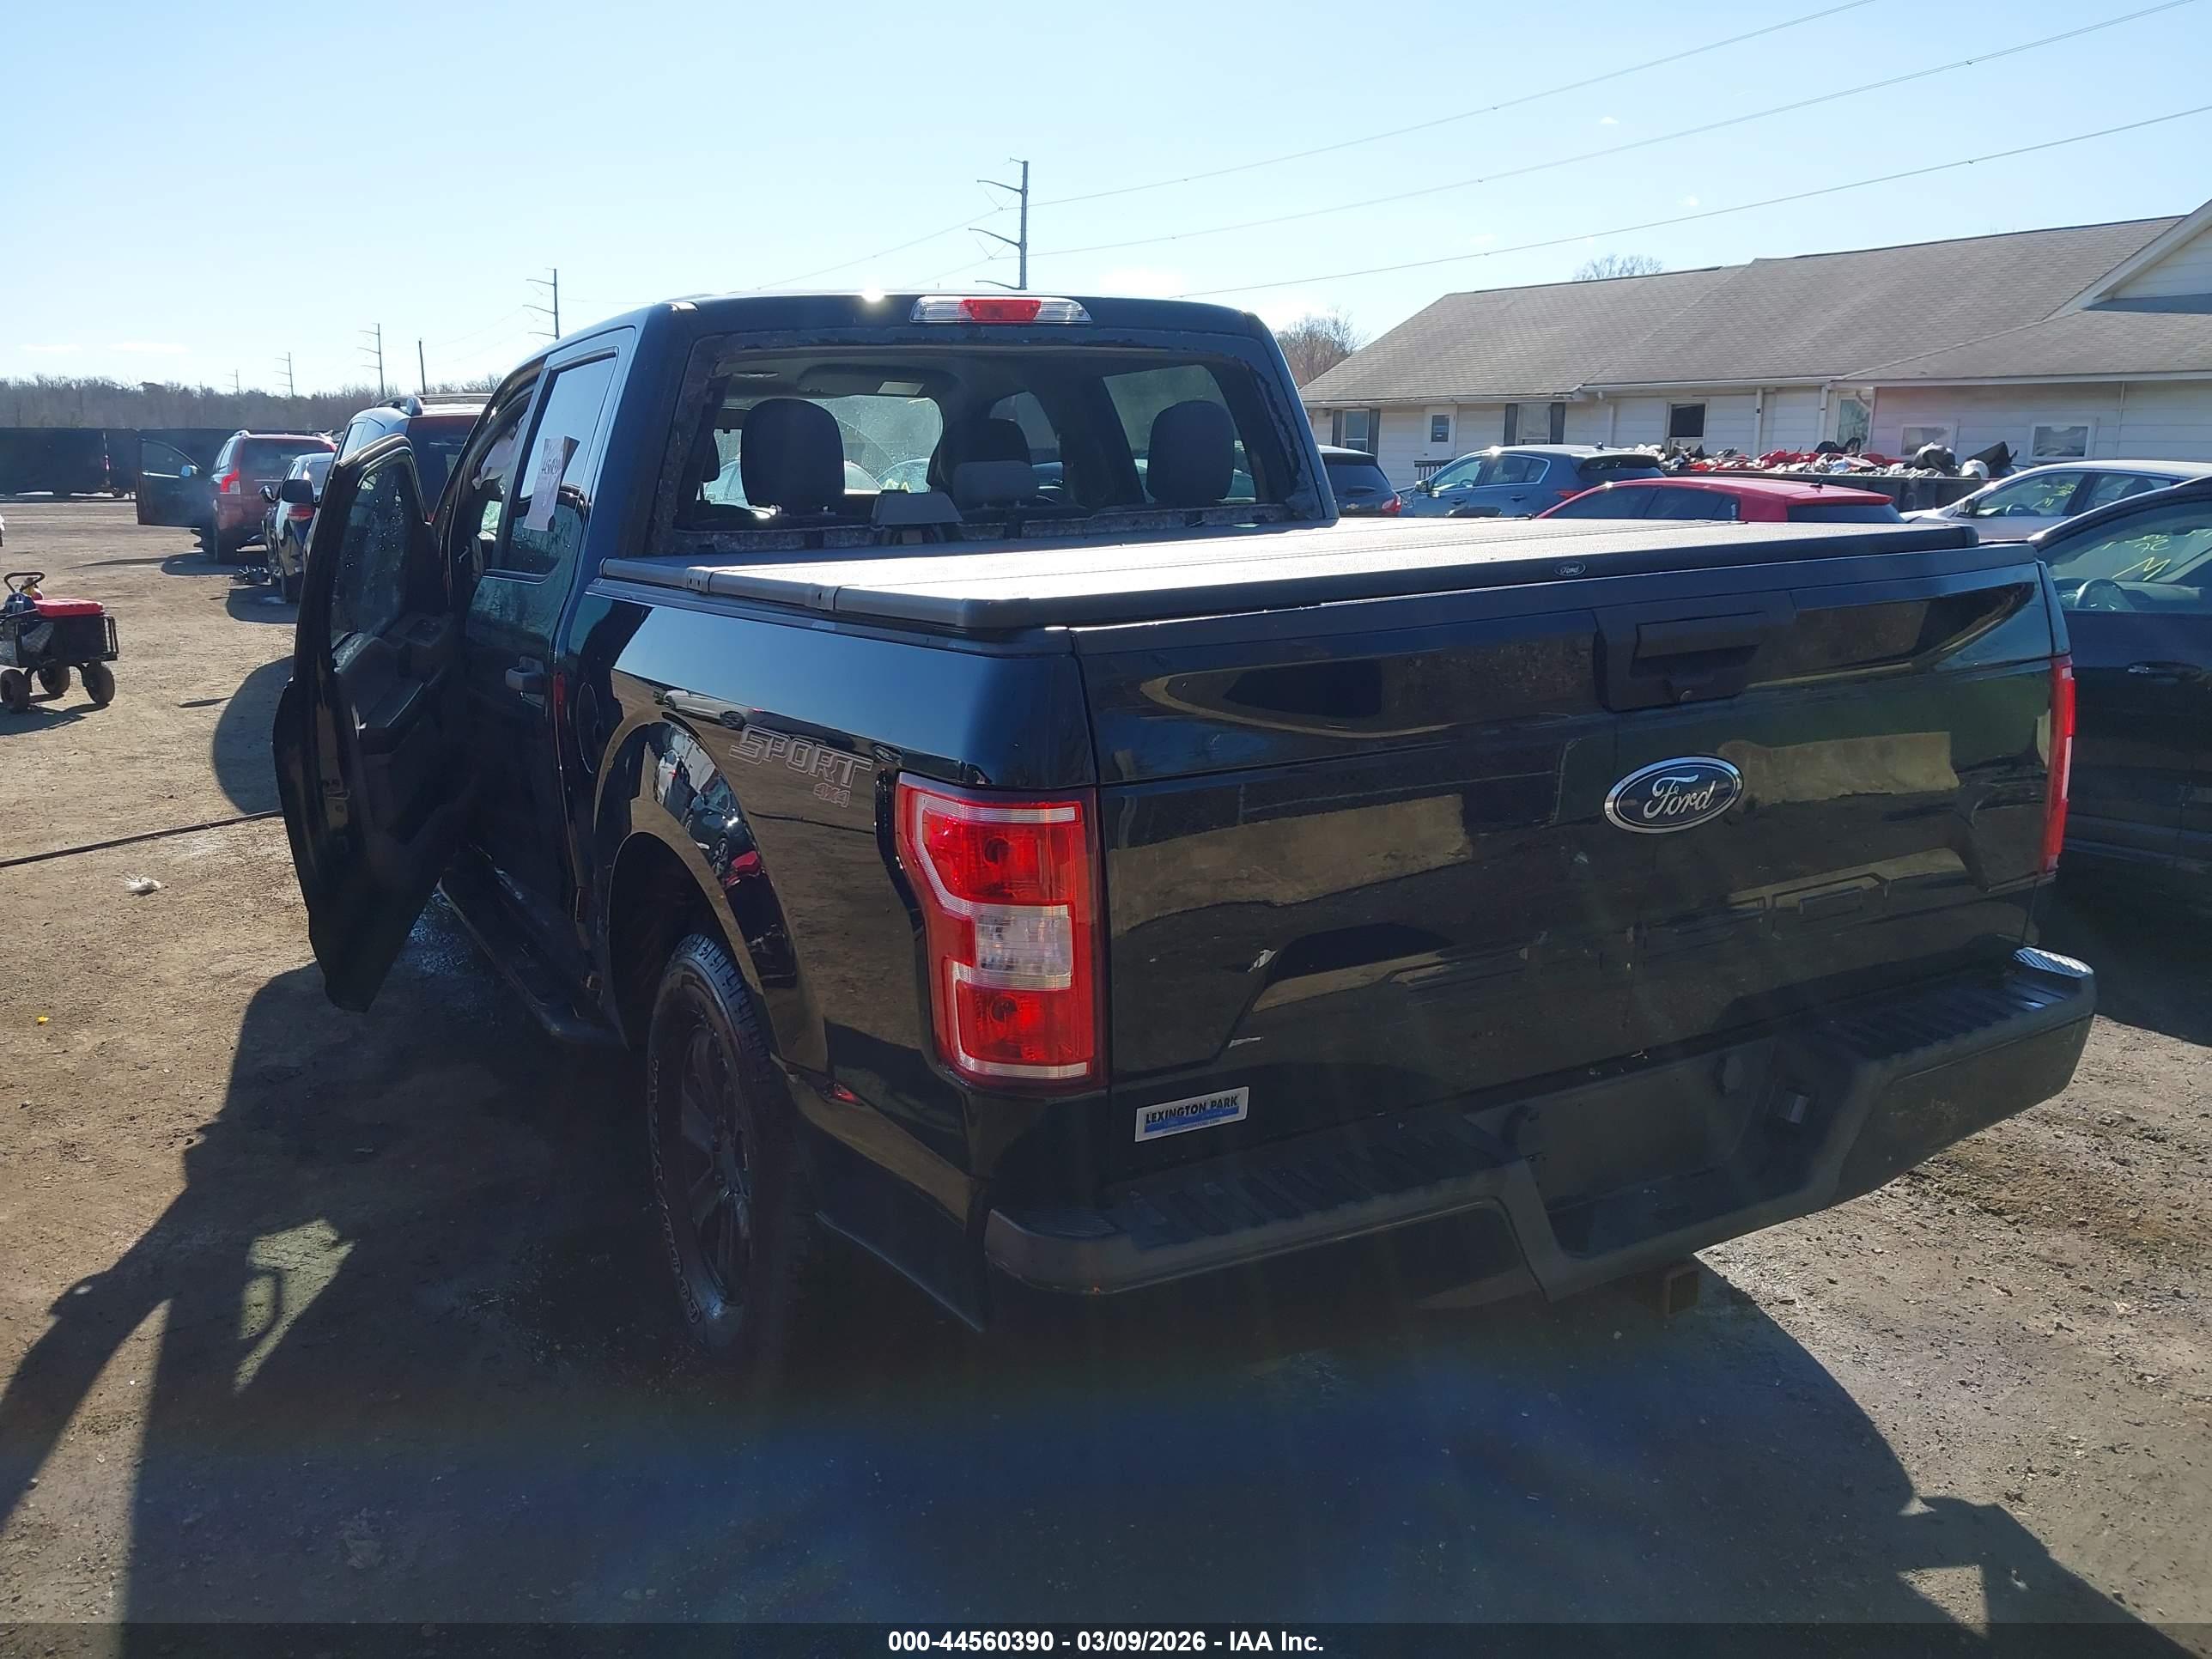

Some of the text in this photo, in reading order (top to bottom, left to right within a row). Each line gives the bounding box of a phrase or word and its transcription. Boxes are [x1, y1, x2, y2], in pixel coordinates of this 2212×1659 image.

[729, 724, 874, 788] SPORT
[1643, 774, 1717, 818] Ford
[1146, 1102, 1206, 1124] LEXINGTON
[1210, 1096, 1239, 1109] PARK
